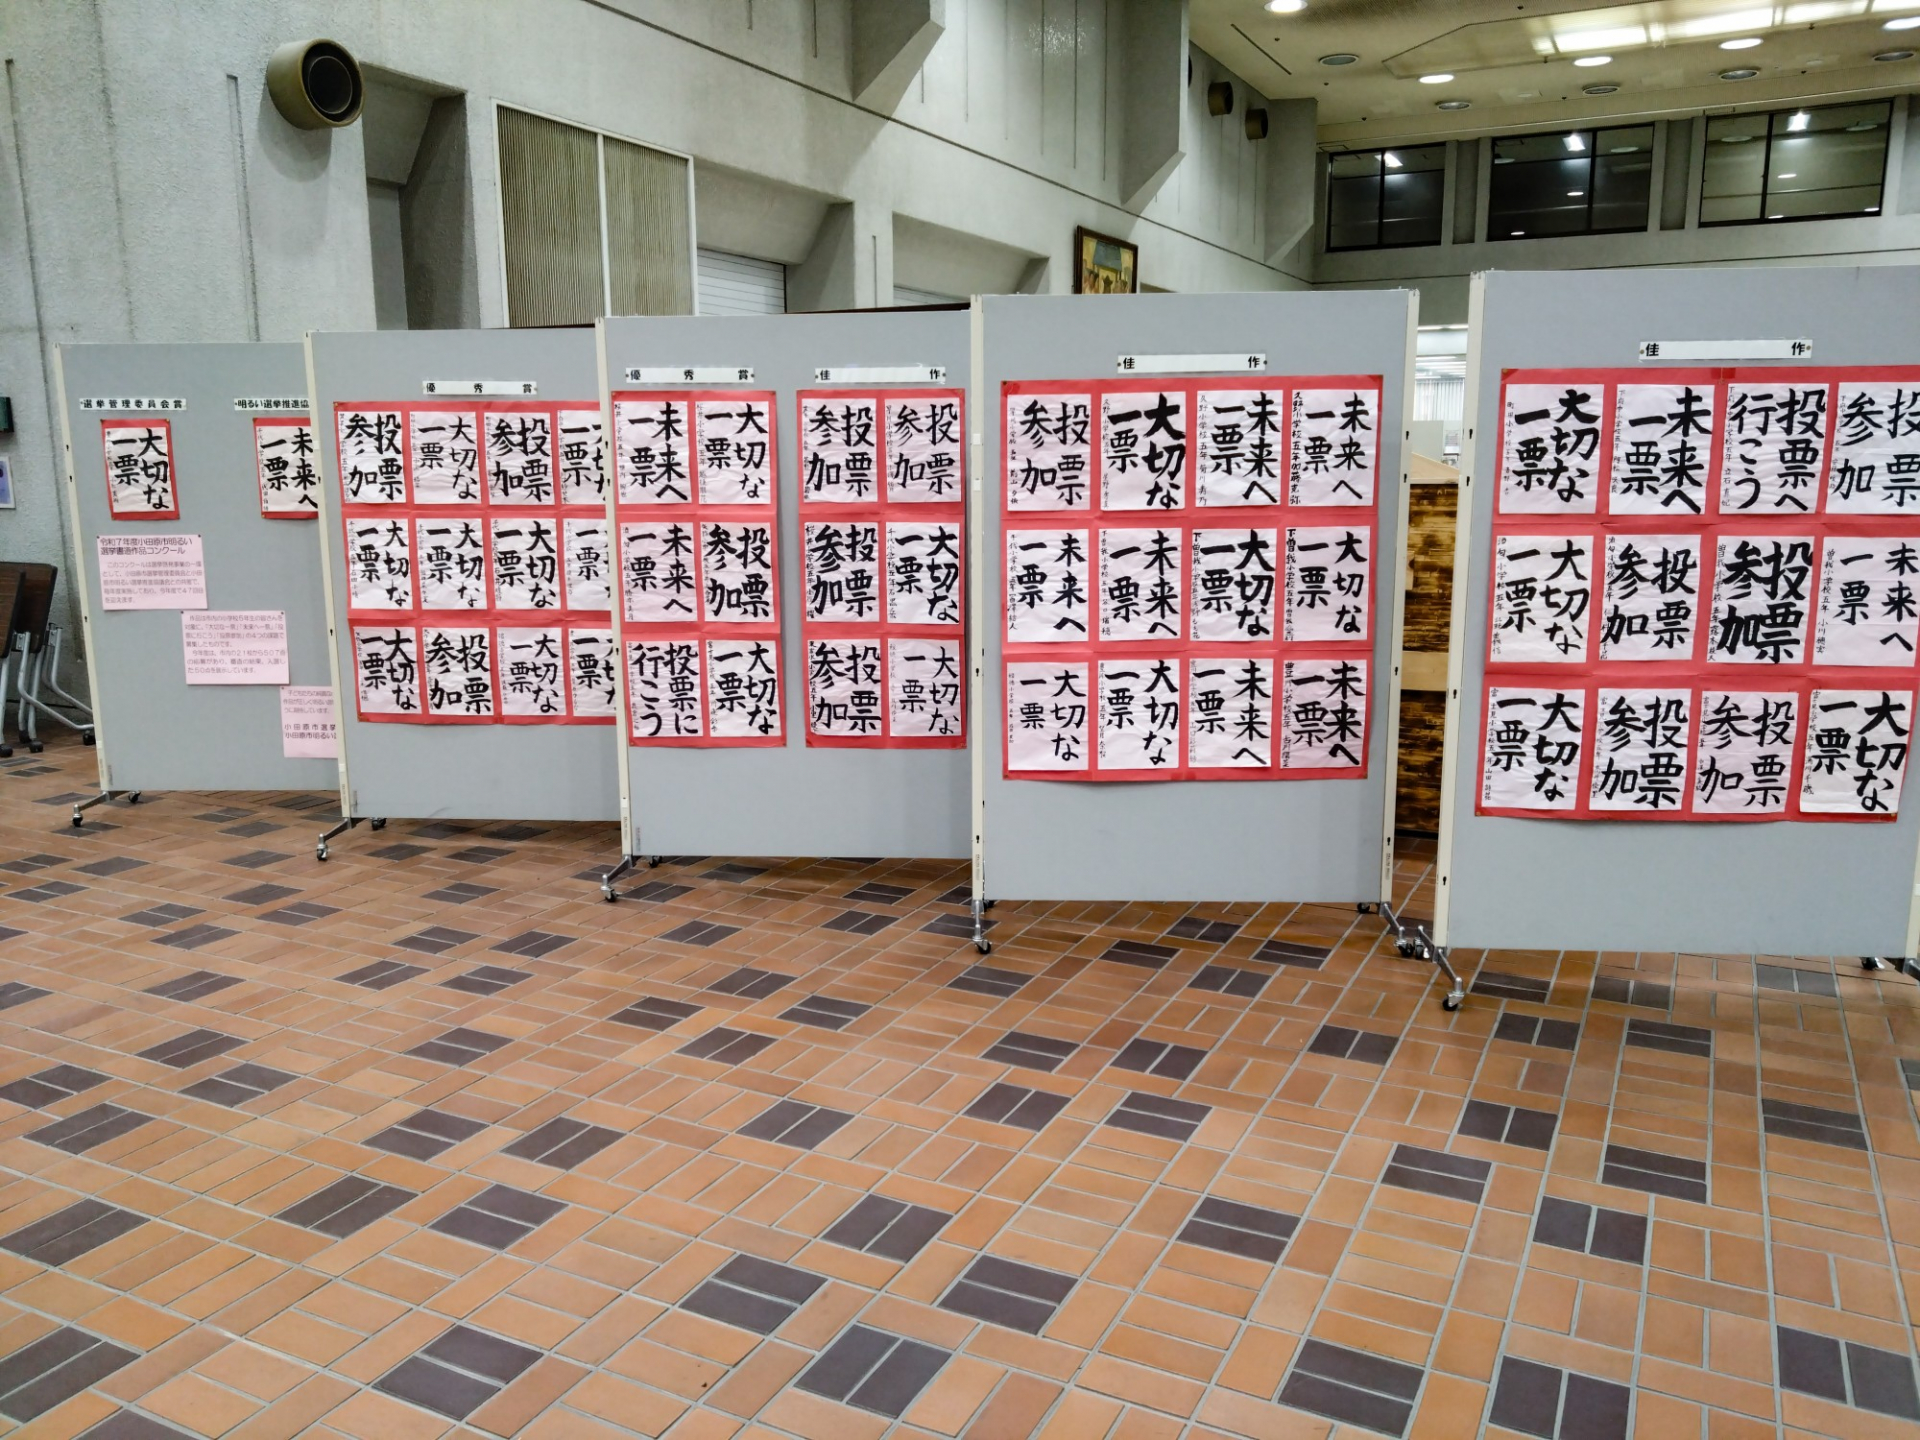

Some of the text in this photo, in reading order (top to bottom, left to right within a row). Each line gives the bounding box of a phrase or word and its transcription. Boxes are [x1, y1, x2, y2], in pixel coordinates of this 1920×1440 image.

[426, 383, 532, 394] 優秀賞
[630, 369, 748, 380] 優秀賞
[820, 369, 940, 380] 佳作
[1123, 356, 1260, 370] 佳作
[1646, 342, 1805, 357] 佳作
[83, 399, 182, 408] 選挙管理委員会賞
[704, 412, 733, 470] 一票
[894, 404, 925, 488] 参加
[1106, 410, 1142, 474] 一票
[1210, 405, 1245, 476] 一票
[1302, 410, 1336, 474] 一票
[1332, 392, 1372, 500] 未来へ
[1548, 389, 1601, 502] 大切な
[1830, 392, 1884, 500] 参加
[112, 438, 140, 486] 一票
[138, 428, 169, 510] 大切な
[260, 438, 289, 492] 一票
[290, 427, 318, 509] 未来へ
[344, 413, 377, 496] 参加
[374, 413, 402, 500] 投票
[418, 426, 446, 470] 一票
[449, 416, 478, 499] 大切な
[488, 418, 524, 496] 参加
[517, 416, 551, 502] 投票
[561, 426, 591, 486] 一票
[628, 418, 656, 488] 一票
[652, 402, 688, 500] 未来へ
[734, 403, 768, 498] 大切な
[806, 404, 841, 492] 参加
[841, 405, 874, 497] 投票
[926, 403, 959, 494] 投票
[1020, 400, 1057, 494] 参加
[1053, 402, 1090, 506] 投票
[1142, 392, 1186, 510] 大切な
[1242, 392, 1281, 504] 未来へ
[1512, 409, 1550, 492] 一票
[1620, 416, 1667, 495] 一票
[1659, 387, 1712, 514] 未来へ
[1728, 392, 1778, 510] 行こう
[1774, 388, 1826, 511] 投票へ
[1881, 388, 1920, 507] 投票
[356, 527, 380, 583] 一票
[383, 520, 410, 607] 大切な
[426, 528, 452, 584] 一票
[454, 522, 483, 608] 大切な
[494, 529, 525, 587] 一票
[525, 520, 556, 608] 大切な
[576, 529, 600, 580] 一票
[628, 532, 657, 592] 一票
[660, 524, 695, 612] 未来へ
[705, 524, 742, 616] 参加
[736, 527, 770, 617] 投票
[810, 524, 846, 615] 参加
[845, 524, 877, 618] 投票
[895, 534, 924, 594] 一票
[926, 526, 959, 623] 大切な
[1016, 542, 1048, 609] 一票
[1052, 533, 1087, 632] 未来へ
[1108, 546, 1142, 623] 一票
[1142, 530, 1180, 636] 未来へ
[1200, 544, 1236, 614] 一票
[1234, 530, 1276, 636] 大切な
[1297, 542, 1332, 609] 一票
[1332, 531, 1367, 633] 大切な
[1501, 548, 1540, 633] 一票
[1539, 540, 1590, 654] 大切な
[1601, 543, 1650, 644] 参加
[1650, 547, 1697, 648] 投票
[1717, 540, 1763, 655] 参加
[1832, 553, 1874, 625] 一票
[1880, 542, 1920, 652] 未来へ
[1755, 541, 1812, 664] 投票
[360, 636, 387, 690] 一票
[384, 628, 417, 710] 大切な
[426, 632, 462, 710] 参加
[456, 634, 491, 714] 投票
[508, 644, 534, 693] 一票
[530, 634, 559, 712] 大切な
[572, 637, 602, 689] 一票
[632, 643, 664, 736] 行こう
[663, 642, 699, 734] 投票に
[714, 652, 746, 712] 一票
[743, 642, 777, 734] 大切な
[810, 642, 848, 729] 参加
[844, 644, 881, 734] 投票
[899, 655, 926, 713] 一票
[928, 646, 960, 734] 大切な
[1020, 678, 1046, 730] 一票
[1105, 672, 1140, 729] 一票
[1193, 669, 1226, 734] 一票
[1050, 670, 1086, 761] 大切な
[1142, 660, 1178, 765] 大切な
[1232, 660, 1270, 764] 未来へ
[1292, 675, 1328, 747] 一票
[1324, 661, 1366, 766] 未来へ
[1492, 698, 1537, 772] 一票
[1532, 692, 1581, 802] 大切な
[1599, 696, 1647, 800] 参加
[1633, 696, 1688, 808] 投票
[1700, 695, 1752, 804] 参加
[1744, 698, 1795, 807] 投票
[1812, 701, 1857, 775] 一票
[1854, 692, 1909, 812] 大切な
